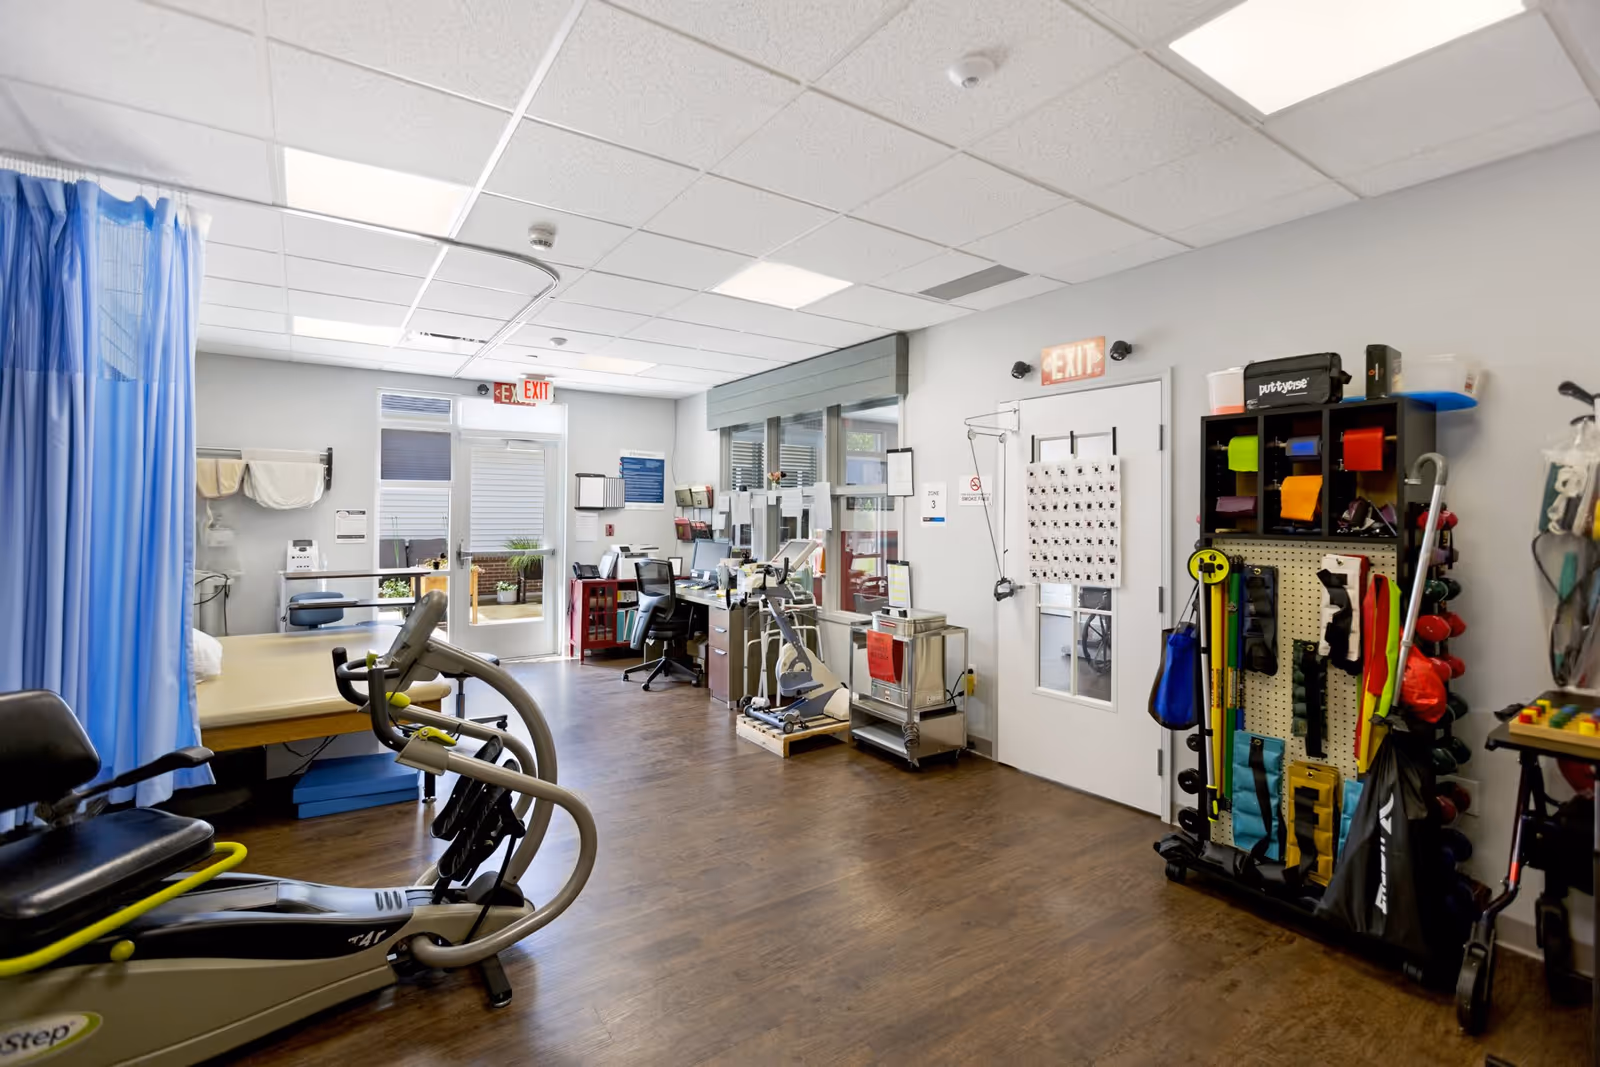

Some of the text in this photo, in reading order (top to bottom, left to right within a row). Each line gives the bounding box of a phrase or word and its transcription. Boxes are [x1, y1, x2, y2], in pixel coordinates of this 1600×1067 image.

[1051, 342, 1097, 380] EXIT
[501, 384, 518, 403] EX
[524, 380, 550, 400] EXIT
[1258, 378, 1308, 397] puttycise
[931, 499, 937, 509] 3
[0, 1024, 71, 1057] Step
